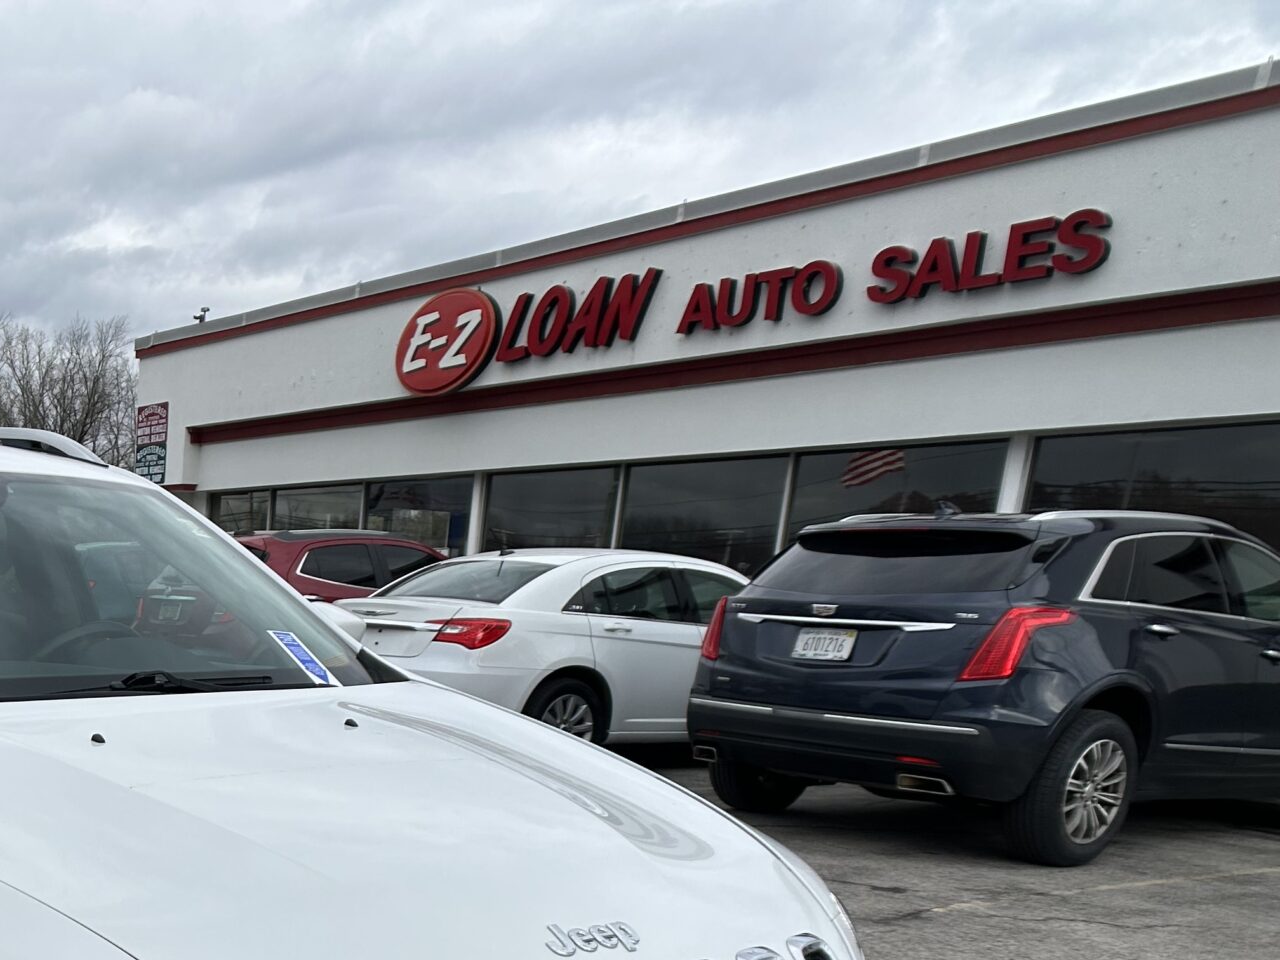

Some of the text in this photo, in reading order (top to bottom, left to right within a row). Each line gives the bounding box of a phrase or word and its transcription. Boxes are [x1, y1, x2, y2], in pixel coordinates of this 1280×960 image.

[402, 208, 1111, 373] E-Z LOAN AUTO SALES
[545, 921, 640, 957] Jeep
